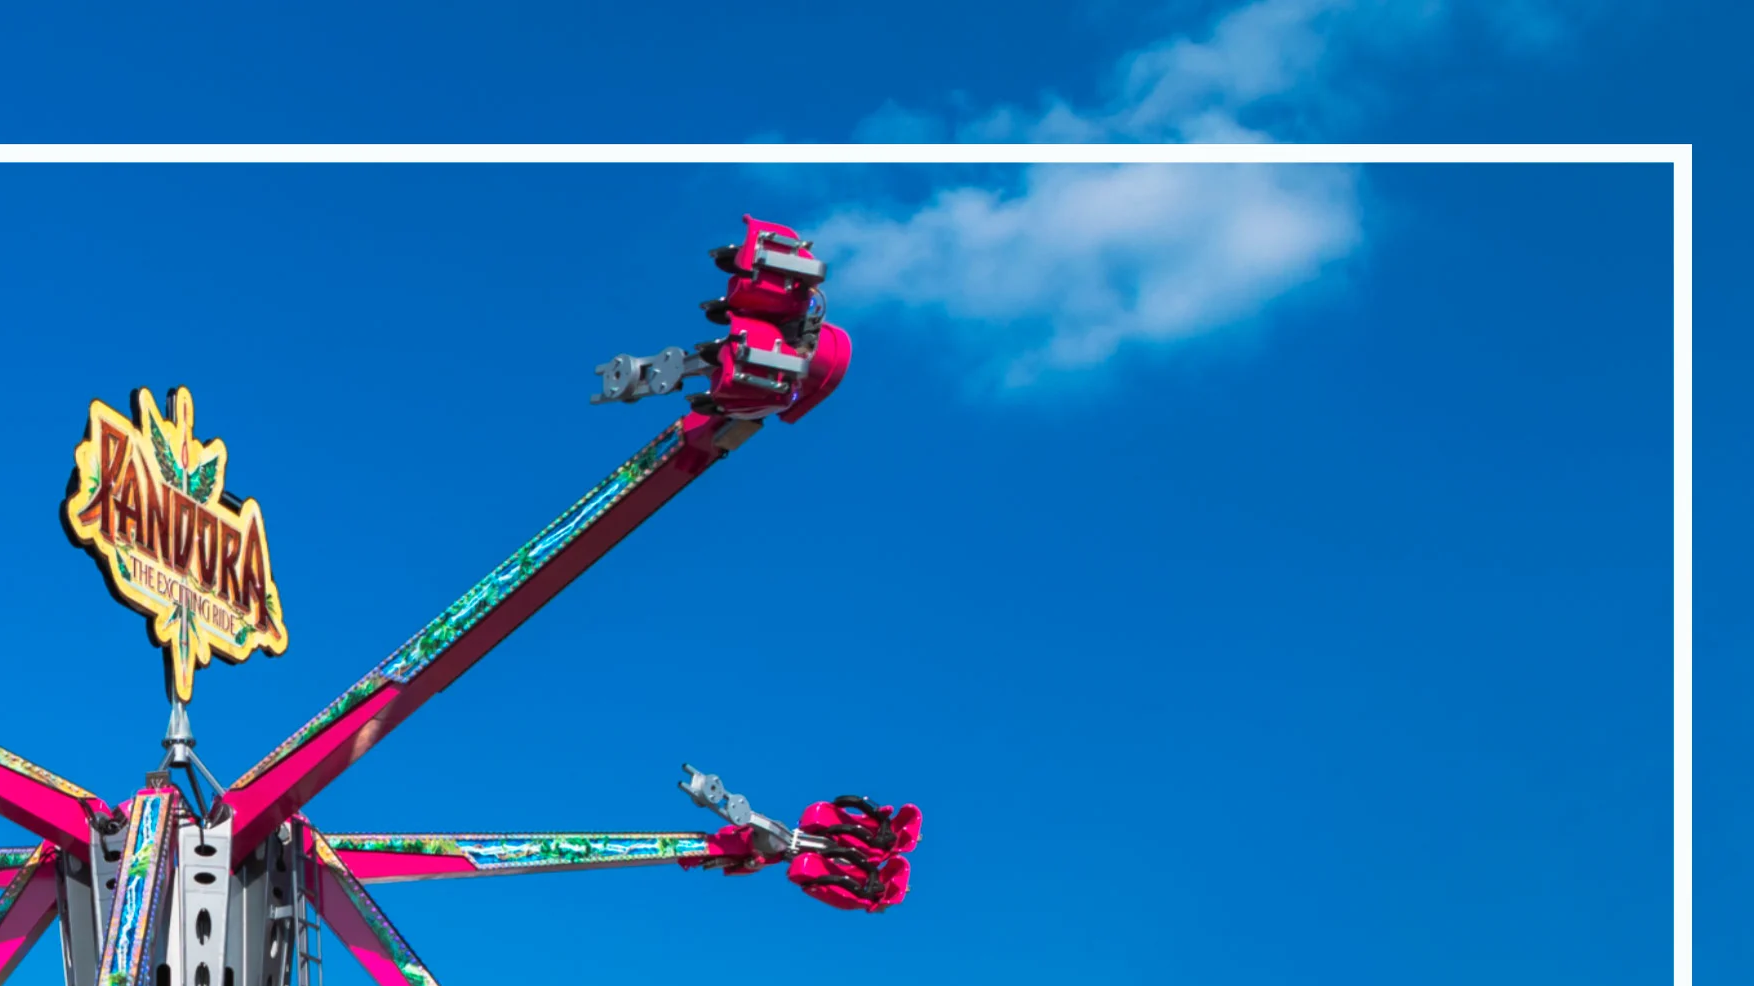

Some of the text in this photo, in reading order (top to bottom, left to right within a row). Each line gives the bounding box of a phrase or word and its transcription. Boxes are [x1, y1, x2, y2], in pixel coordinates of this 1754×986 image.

[78, 418, 282, 640] PANDORA
[130, 555, 236, 636] THE EXCITING RIDE
